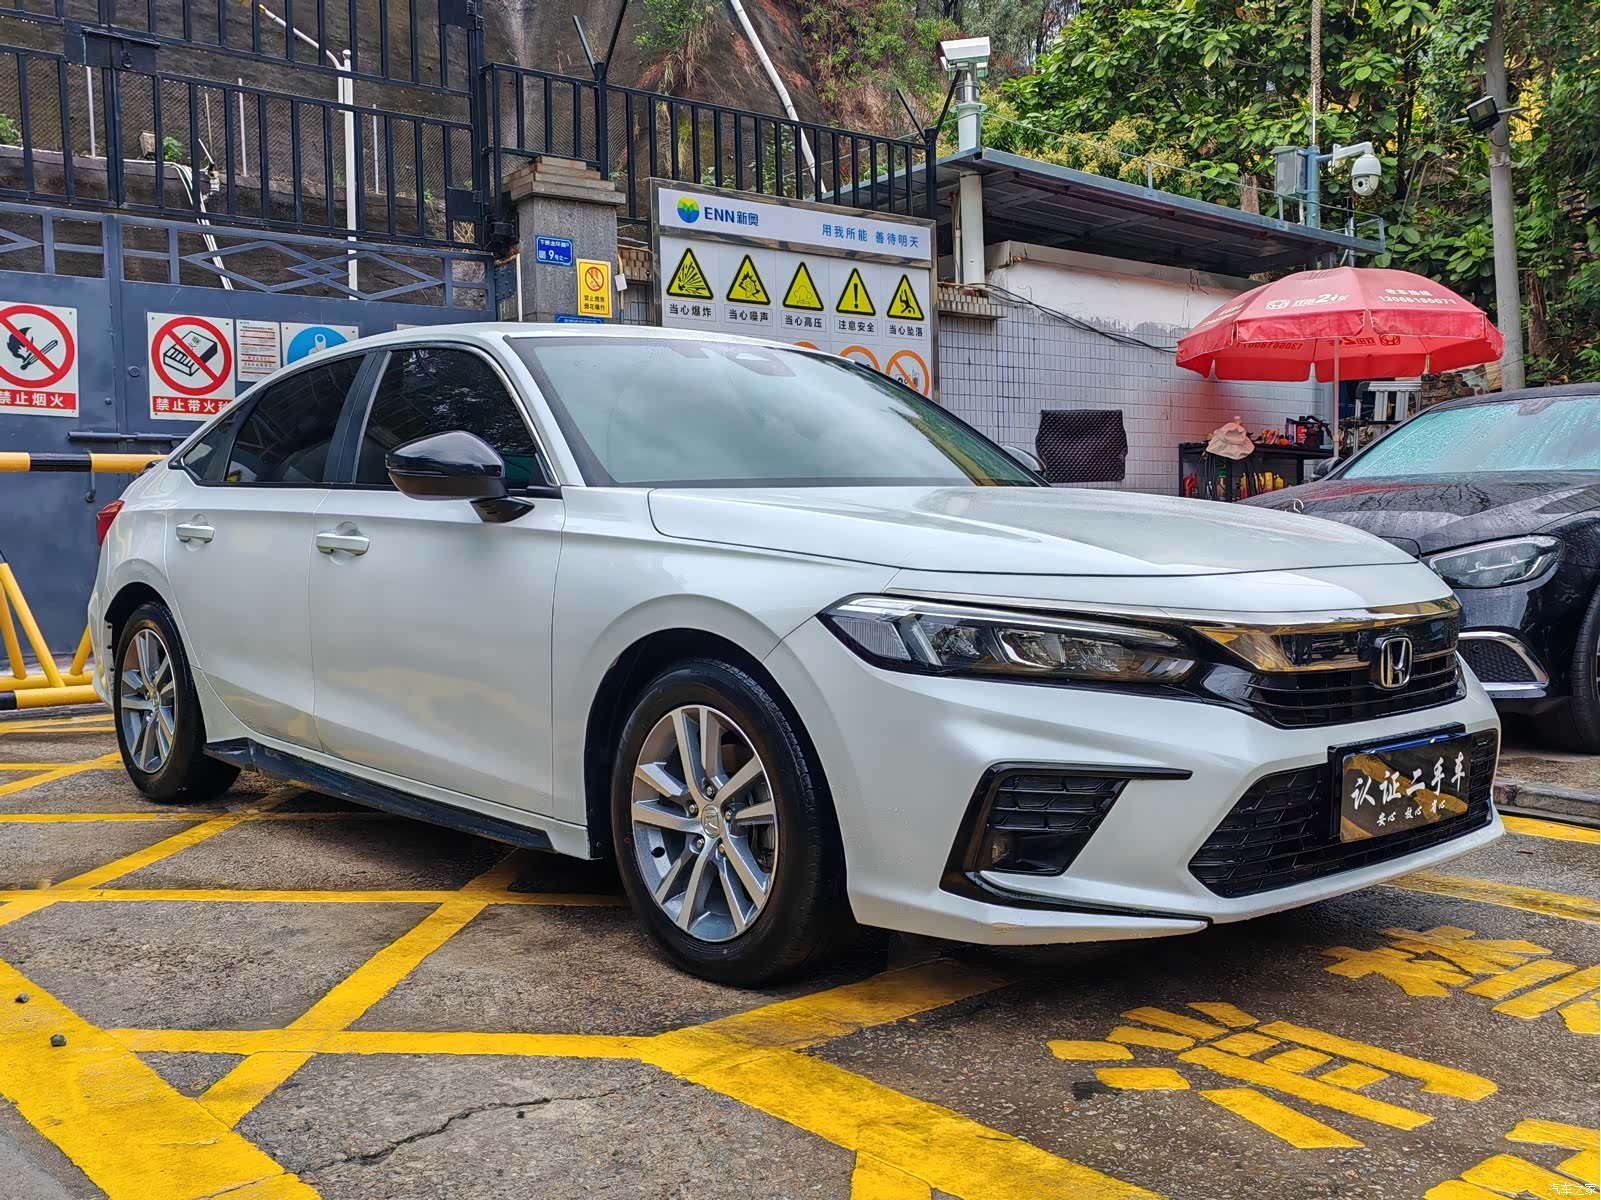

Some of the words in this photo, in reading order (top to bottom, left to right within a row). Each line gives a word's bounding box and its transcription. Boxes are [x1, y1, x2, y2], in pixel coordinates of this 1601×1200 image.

[822, 223, 868, 241] 用我所能
[875, 231, 919, 248] 善待明天
[669, 303, 712, 318] 当心爆炸
[729, 308, 769, 322] 当心噪声
[785, 314, 823, 328] 当心高压
[838, 319, 875, 333] 注意安全
[889, 324, 923, 337] 当心坠落
[0, 391, 64, 408] 禁止烟火
[1350, 751, 1466, 810] 认证二手车
[1376, 811, 1397, 827] 安心
